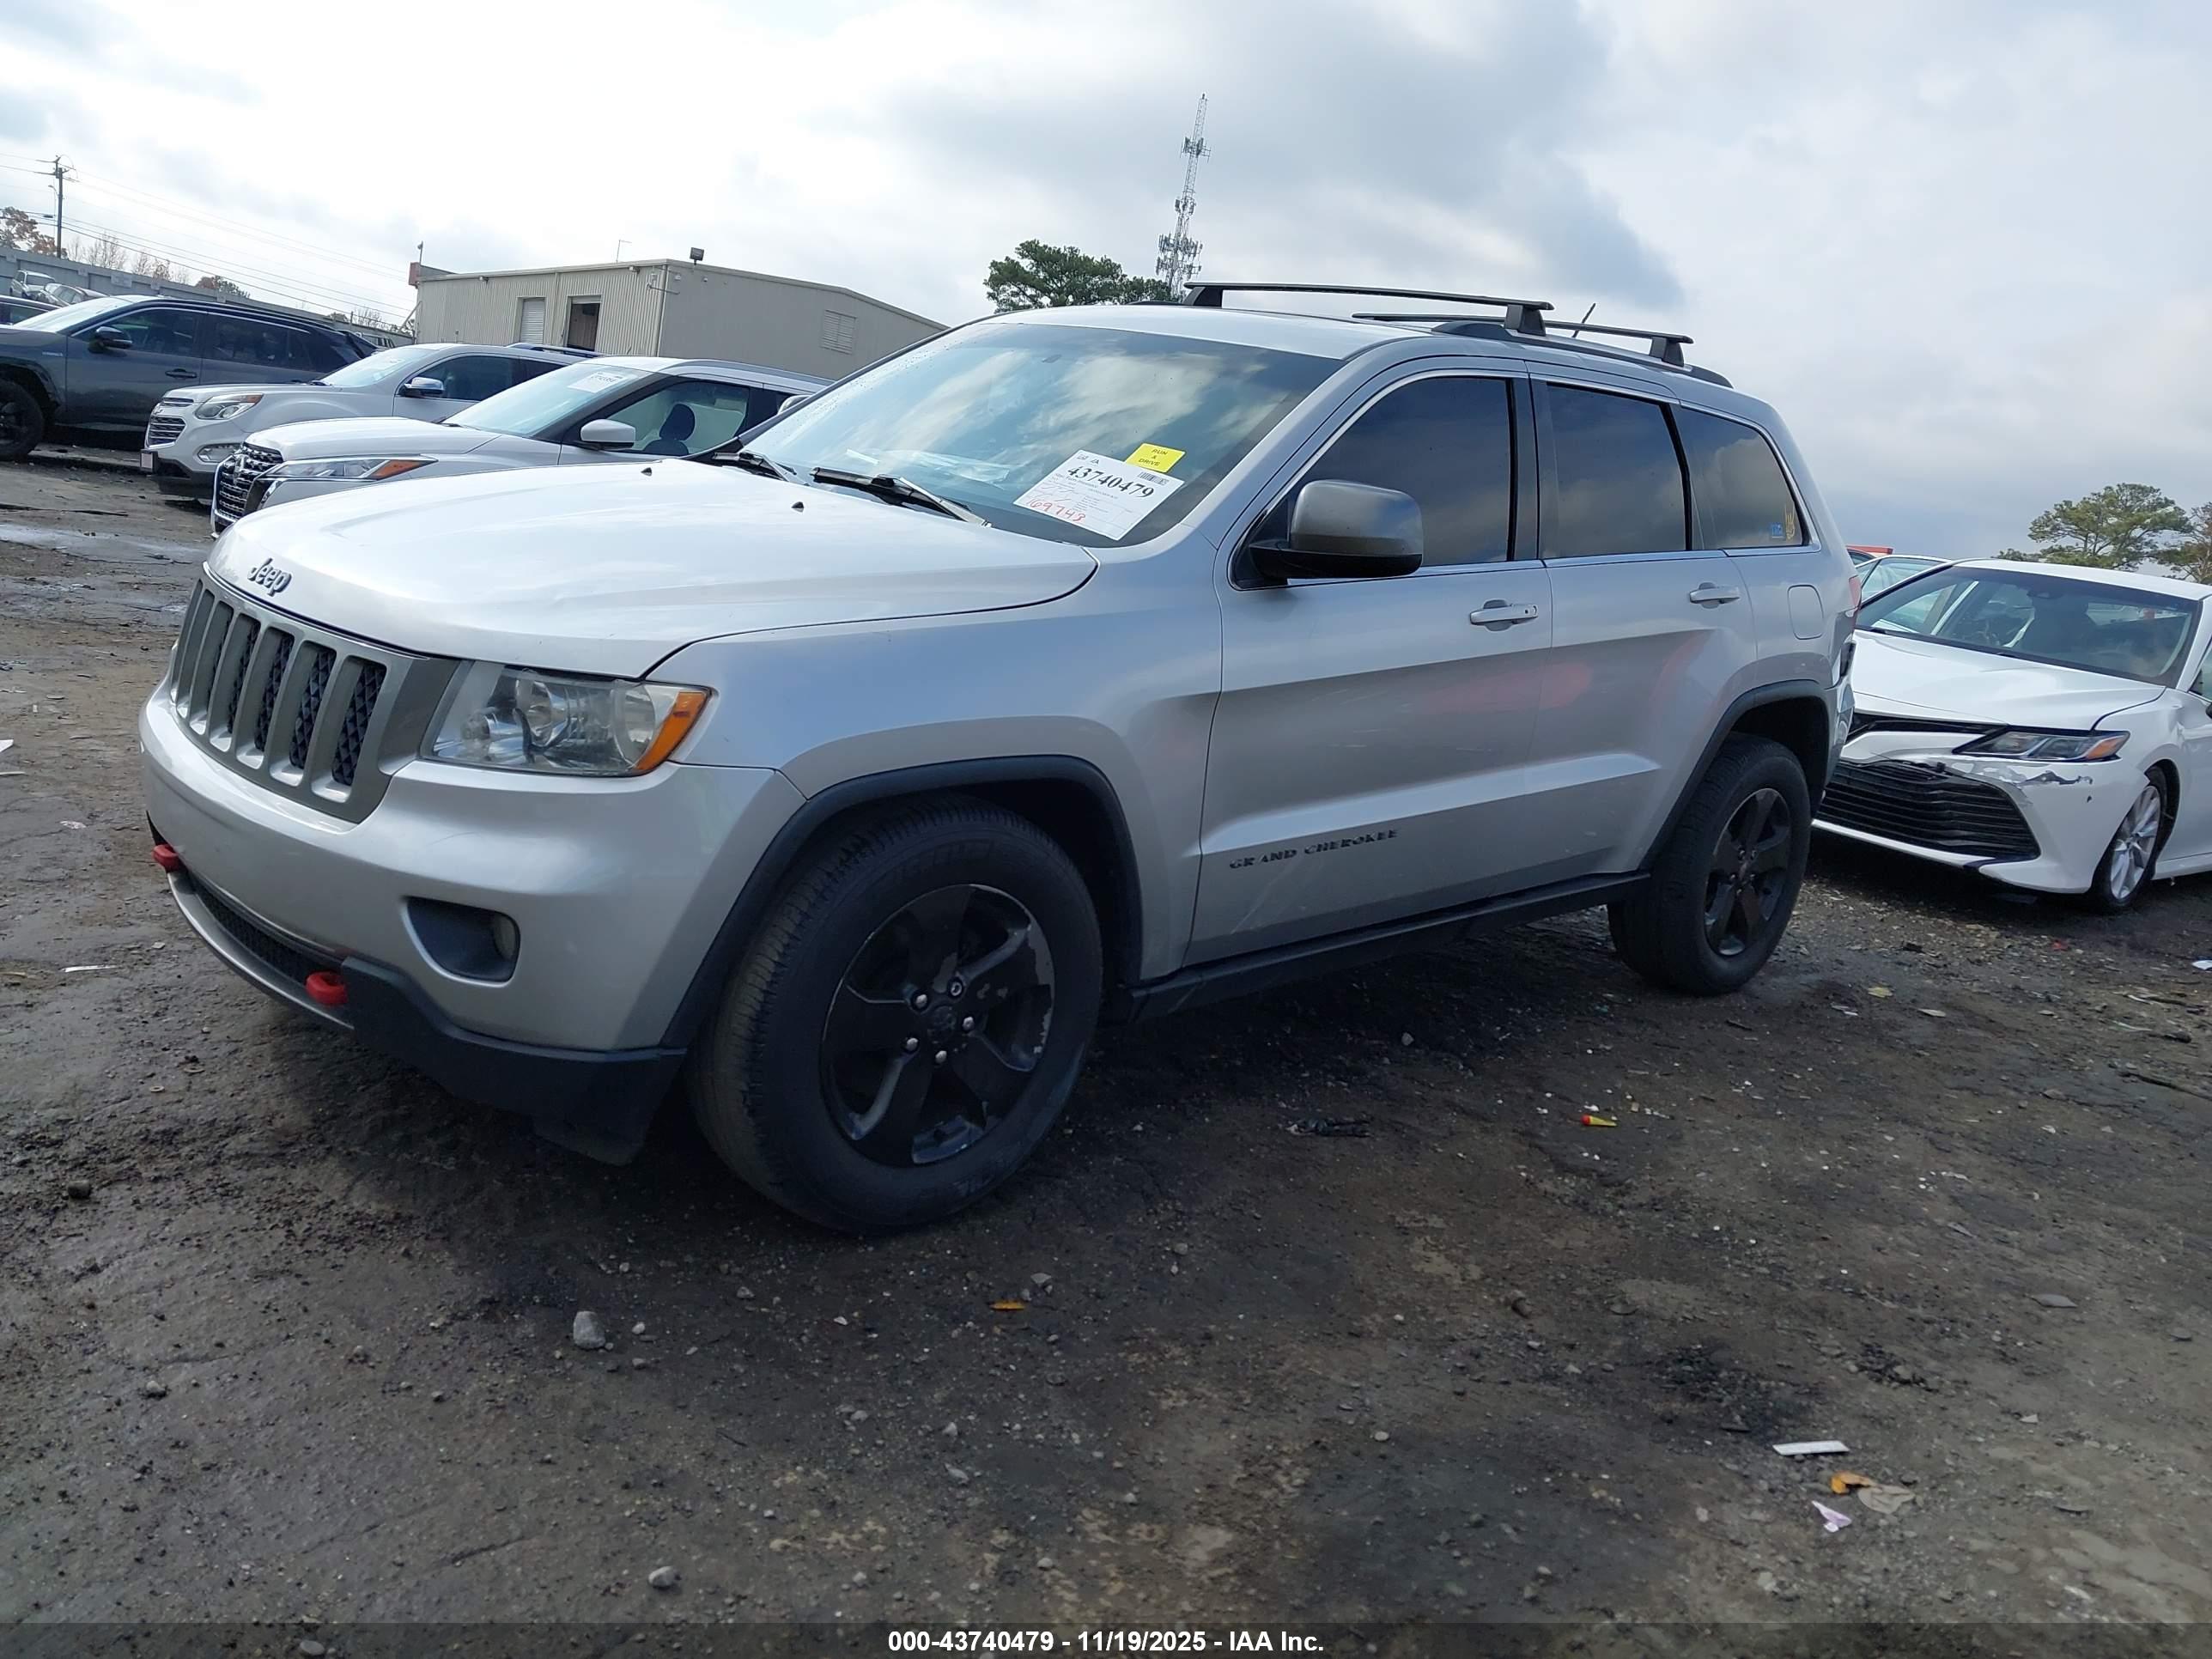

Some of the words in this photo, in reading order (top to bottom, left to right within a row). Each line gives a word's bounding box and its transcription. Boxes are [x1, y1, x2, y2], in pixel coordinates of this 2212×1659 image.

[1067, 465, 1155, 498] 43740479
[247, 557, 292, 597] Jeep
[1229, 849, 1297, 869] GRAND
[1304, 830, 1399, 854] CHEROKEE
